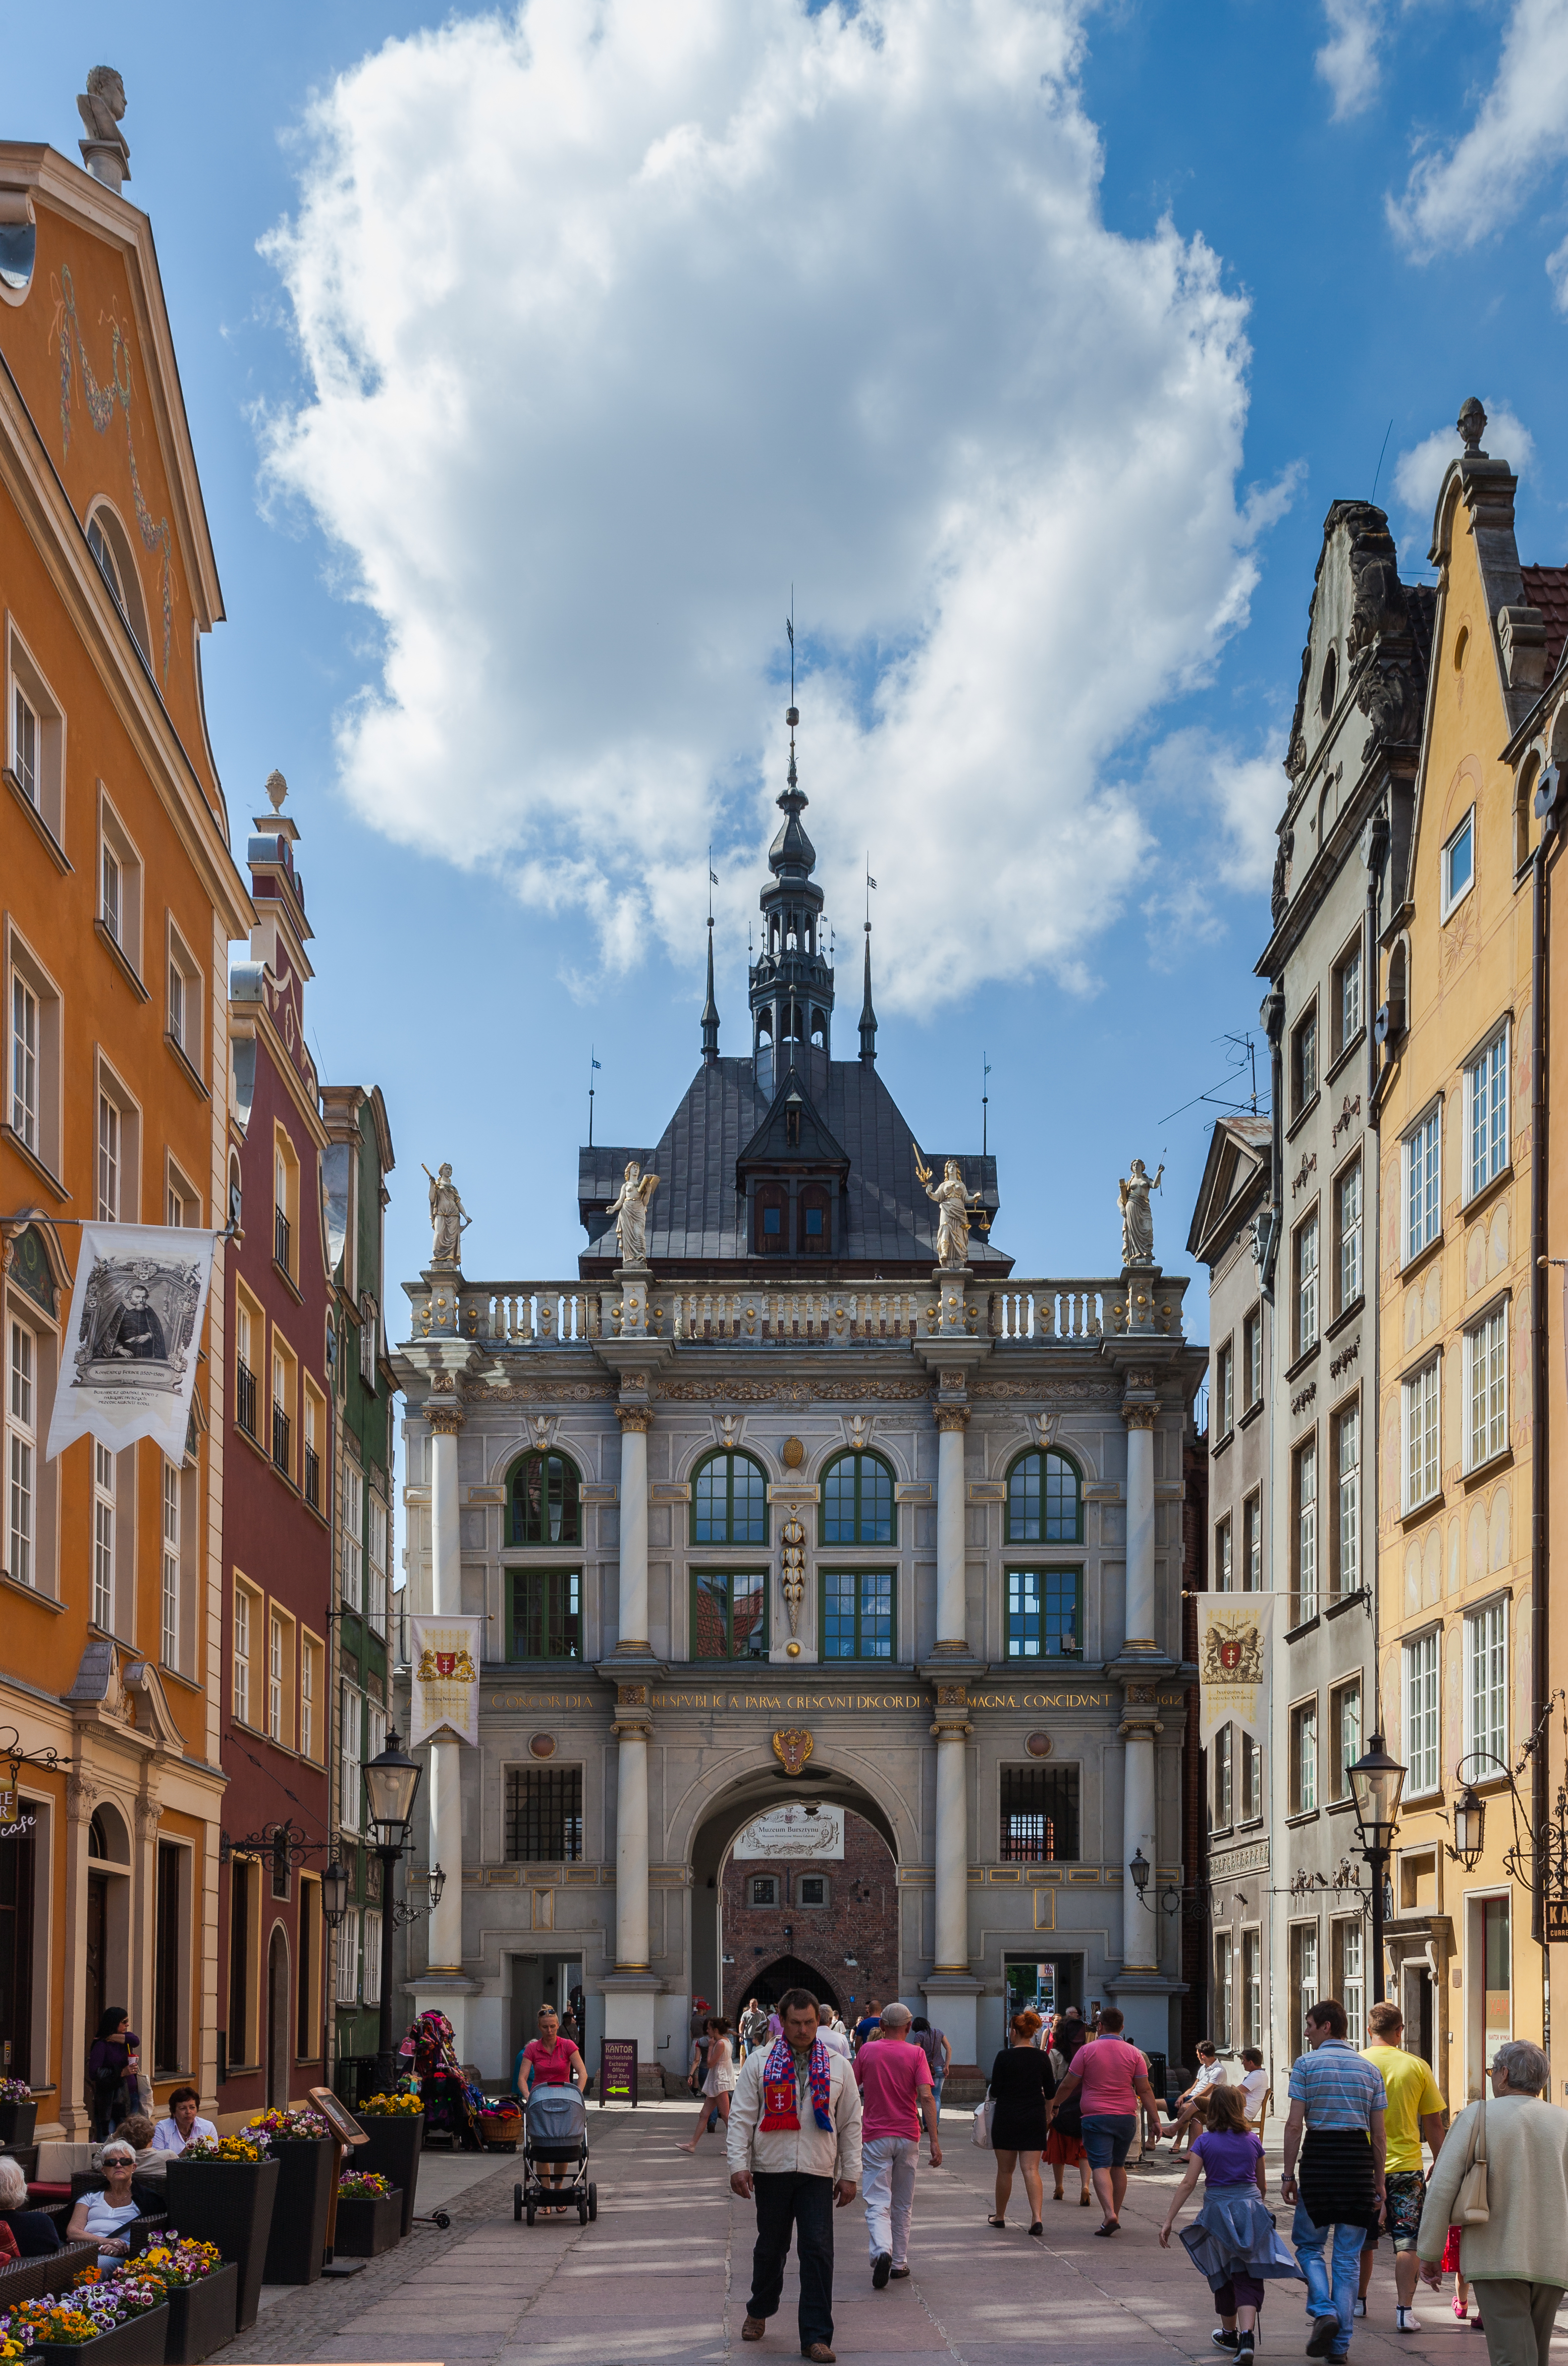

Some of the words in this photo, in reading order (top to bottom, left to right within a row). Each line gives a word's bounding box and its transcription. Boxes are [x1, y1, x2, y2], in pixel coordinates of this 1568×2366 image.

[491, 1694, 594, 1708] CONCORDIA
[787, 1696, 856, 1709] CRESCVNT
[1024, 1694, 1113, 1707] CONCIDVNT
[1157, 1695, 1182, 1705] 1612
[1, 1816, 37, 1836] cafe
[787, 1826, 819, 1834] Bursztynu
[605, 2045, 633, 2053] KANTOR
